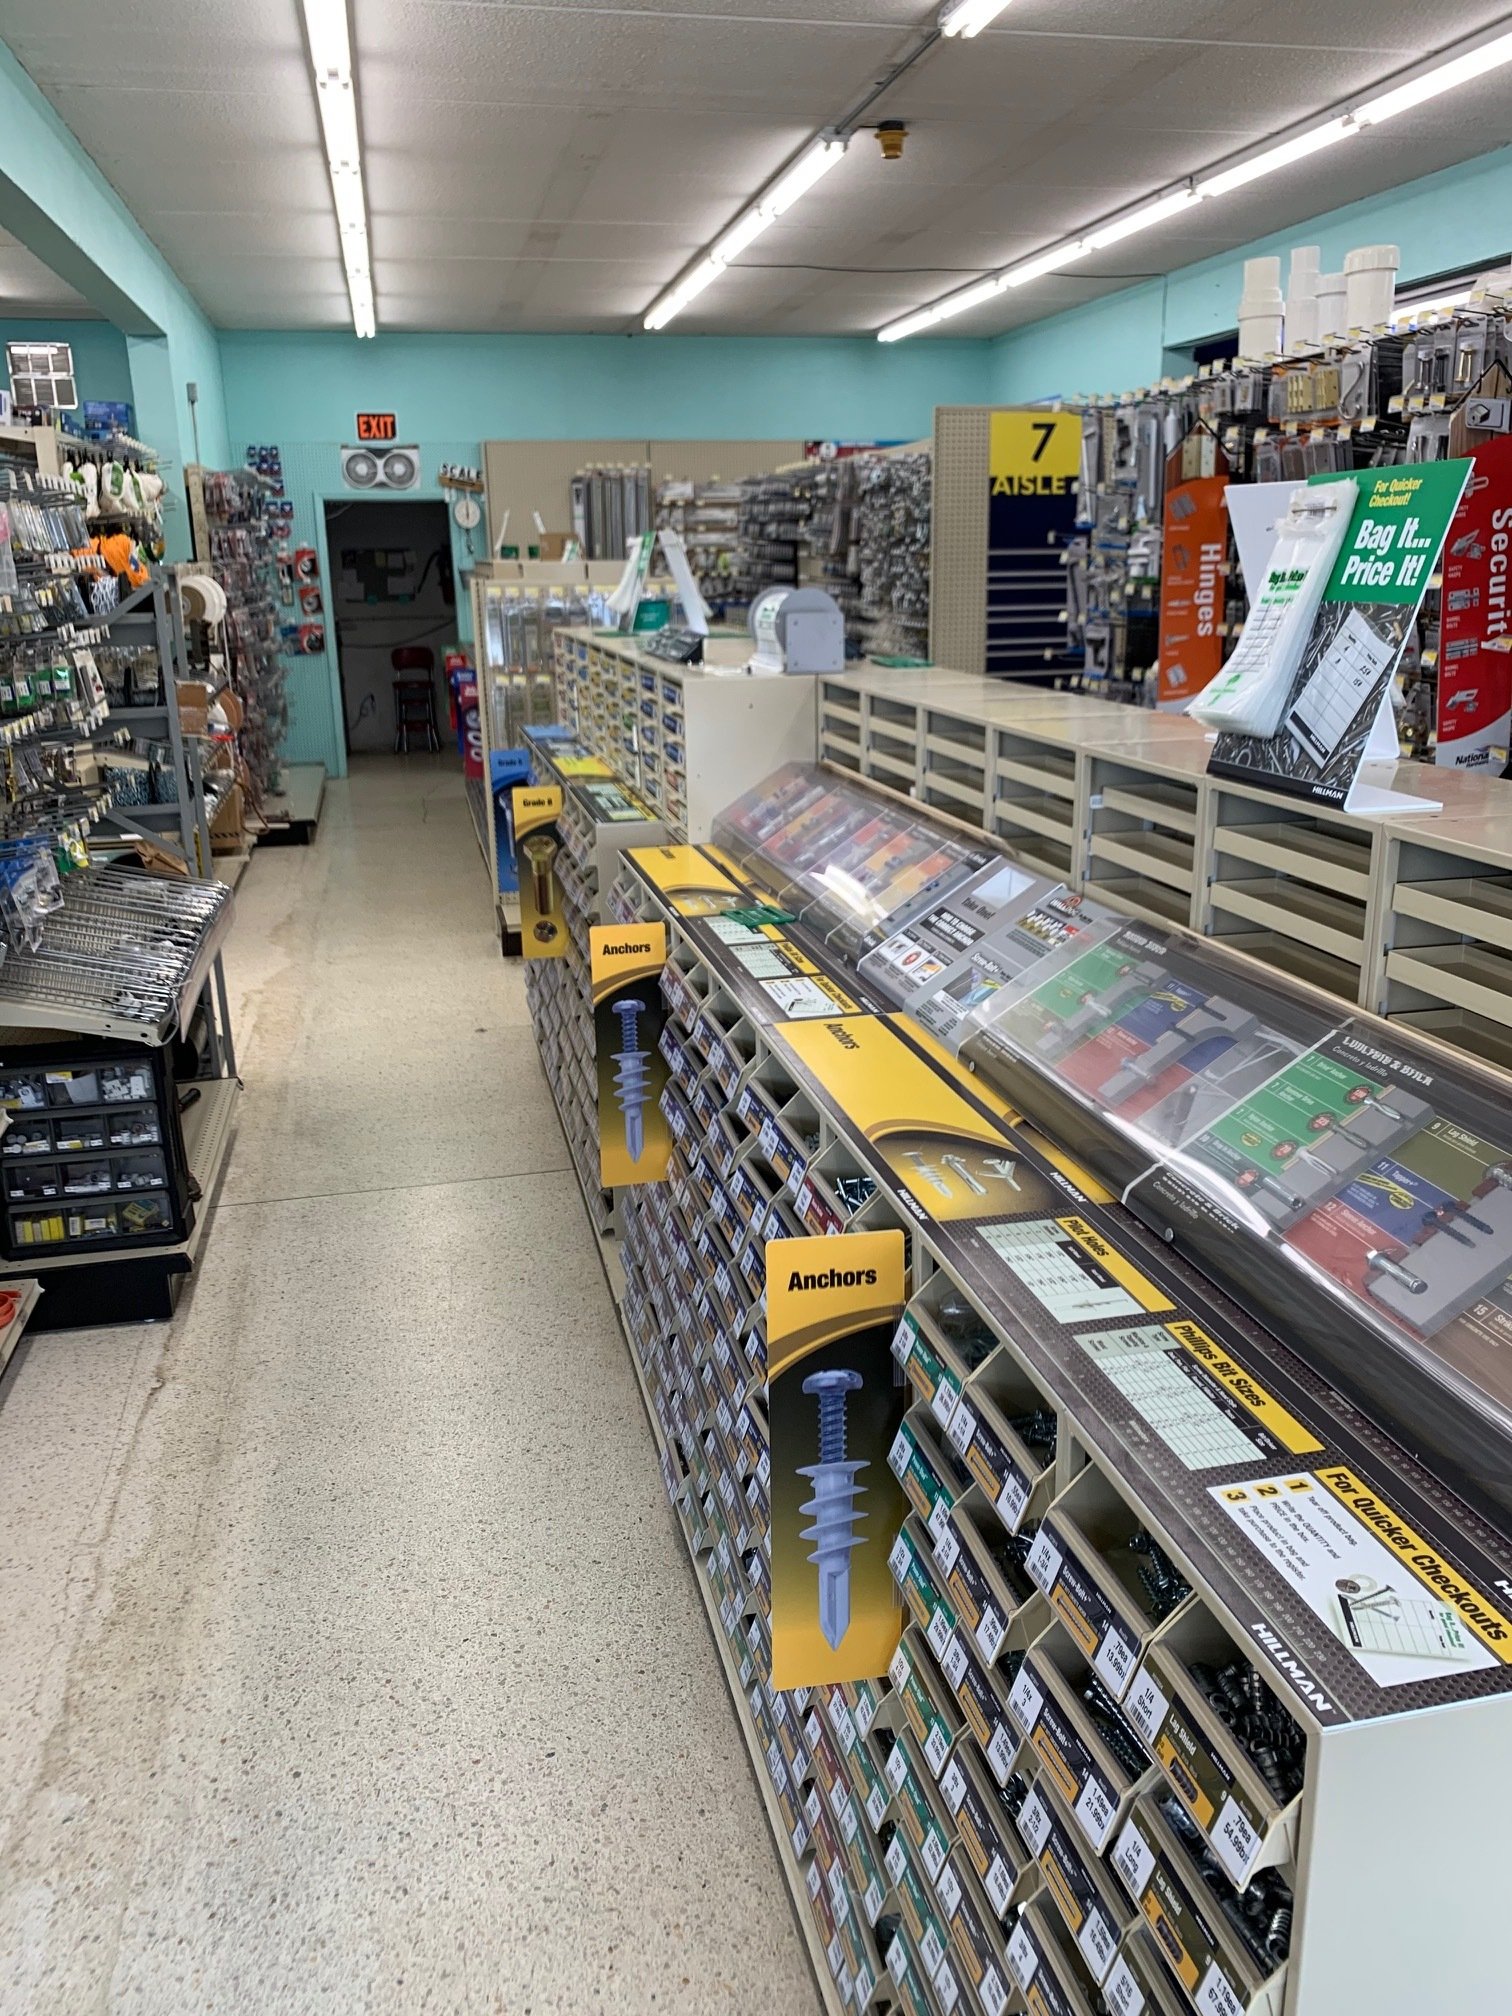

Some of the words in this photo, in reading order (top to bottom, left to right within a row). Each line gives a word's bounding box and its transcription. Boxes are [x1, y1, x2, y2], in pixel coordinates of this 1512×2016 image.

[358, 415, 394, 439] EXIT
[1031, 423, 1057, 463] 7
[992, 475, 1066, 495] AISLE
[1374, 480, 1388, 493] For
[1389, 478, 1423, 493] Quicker
[1369, 493, 1412, 508] Checkout!
[1354, 519, 1397, 556] Bag
[1397, 517, 1432, 549] It...
[1341, 555, 1394, 586] Price
[1396, 554, 1426, 587] It!
[1487, 508, 1512, 636] Securit
[1194, 543, 1222, 637] Hinges
[1455, 752, 1489, 765] Nationa
[523, 798, 546, 808] Grade
[1312, 785, 1344, 800] HILLMAN
[926, 913, 938, 924] THE
[934, 918, 957, 936] CORRECT
[953, 930, 974, 947] ANCHOR
[940, 910, 954, 922] HOW
[951, 917, 960, 926] TO
[958, 920, 976, 936] CHOOSE
[602, 942, 651, 956] Anchors
[823, 1022, 860, 1050] Anchors
[1306, 1055, 1315, 1063] 7
[1332, 1045, 1359, 1062] Concreto
[1364, 1062, 1387, 1079] ladrillo
[1431, 1120, 1441, 1132] 9
[1446, 1126, 1461, 1139] Lag
[1458, 1131, 1478, 1149] Shield
[1377, 1160, 1388, 1170] 11
[1050, 1171, 1087, 1202] HILLMAN
[895, 1188, 929, 1221] HILLMAN
[1325, 1199, 1336, 1210] 12
[1356, 1219, 1377, 1237] Anchor
[1065, 1219, 1089, 1240] Pilot
[1083, 1232, 1109, 1257] Holes
[788, 1267, 877, 1291] Anchors
[1473, 1304, 1488, 1316] 15
[1174, 1325, 1216, 1361] Phillips
[1213, 1361, 1238, 1382] Bit
[1230, 1377, 1266, 1409] Sizes
[1256, 1486, 1278, 1496] 2
[1281, 1500, 1297, 1514] Write
[1294, 1513, 1304, 1523] the
[1302, 1522, 1331, 1548] QUANTITY
[1326, 1548, 1341, 1559] and
[1269, 1502, 1288, 1517] PRICE
[1289, 1522, 1300, 1532] the
[1297, 1531, 1310, 1543] box.
[1289, 1481, 1309, 1490] 1
[1307, 1495, 1320, 1507] Tear
[1317, 1505, 1330, 1515] off
[1324, 1514, 1349, 1535] product
[1344, 1534, 1358, 1547] bag.
[1227, 1492, 1247, 1501] 3
[1249, 1505, 1265, 1519] Place
[1261, 1519, 1284, 1540] product
[1285, 1545, 1298, 1557] bag
[1296, 1556, 1310, 1567] and
[1041, 1545, 1052, 1562] 1/4x
[1238, 1507, 1251, 1519] take
[1246, 1519, 1272, 1542] purchase
[1275, 1548, 1286, 1558] the
[1283, 1558, 1306, 1581] register.
[1326, 1473, 1358, 1494] For
[1353, 1498, 1418, 1551] Quicker
[1411, 1554, 1508, 1641] Checkouts
[1102, 1619, 1109, 1632] 14
[1113, 1640, 1128, 1664] .79ea
[1251, 1623, 1331, 1712] HILLMAN
[1021, 1698, 1027, 1707] 3
[1022, 1684, 1033, 1702] 1/4x
[1137, 1693, 1152, 1720] Short
[1144, 1687, 1155, 1705] 1/4
[1169, 1713, 1180, 1734] Lag
[1179, 1728, 1197, 1756] Shield
[1220, 1790, 1228, 1801] 9
[1210, 1752, 1230, 1781] HILLMAN
[1081, 1767, 1089, 1781] 14
[1092, 1788, 1109, 1815] 1.49ea
[1232, 1815, 1252, 1844] .79ea
[1125, 1847, 1139, 1874] Long
[1132, 1840, 1142, 1857] 1/4
[1155, 1871, 1165, 1892] Lag
[1165, 1887, 1183, 1916] Shield
[1205, 1955, 1212, 1966] 9
[1115, 1983, 1129, 2011] Short
[1120, 1974, 1133, 1998] 5/16
[1217, 1978, 1237, 2016] 1.19ea
